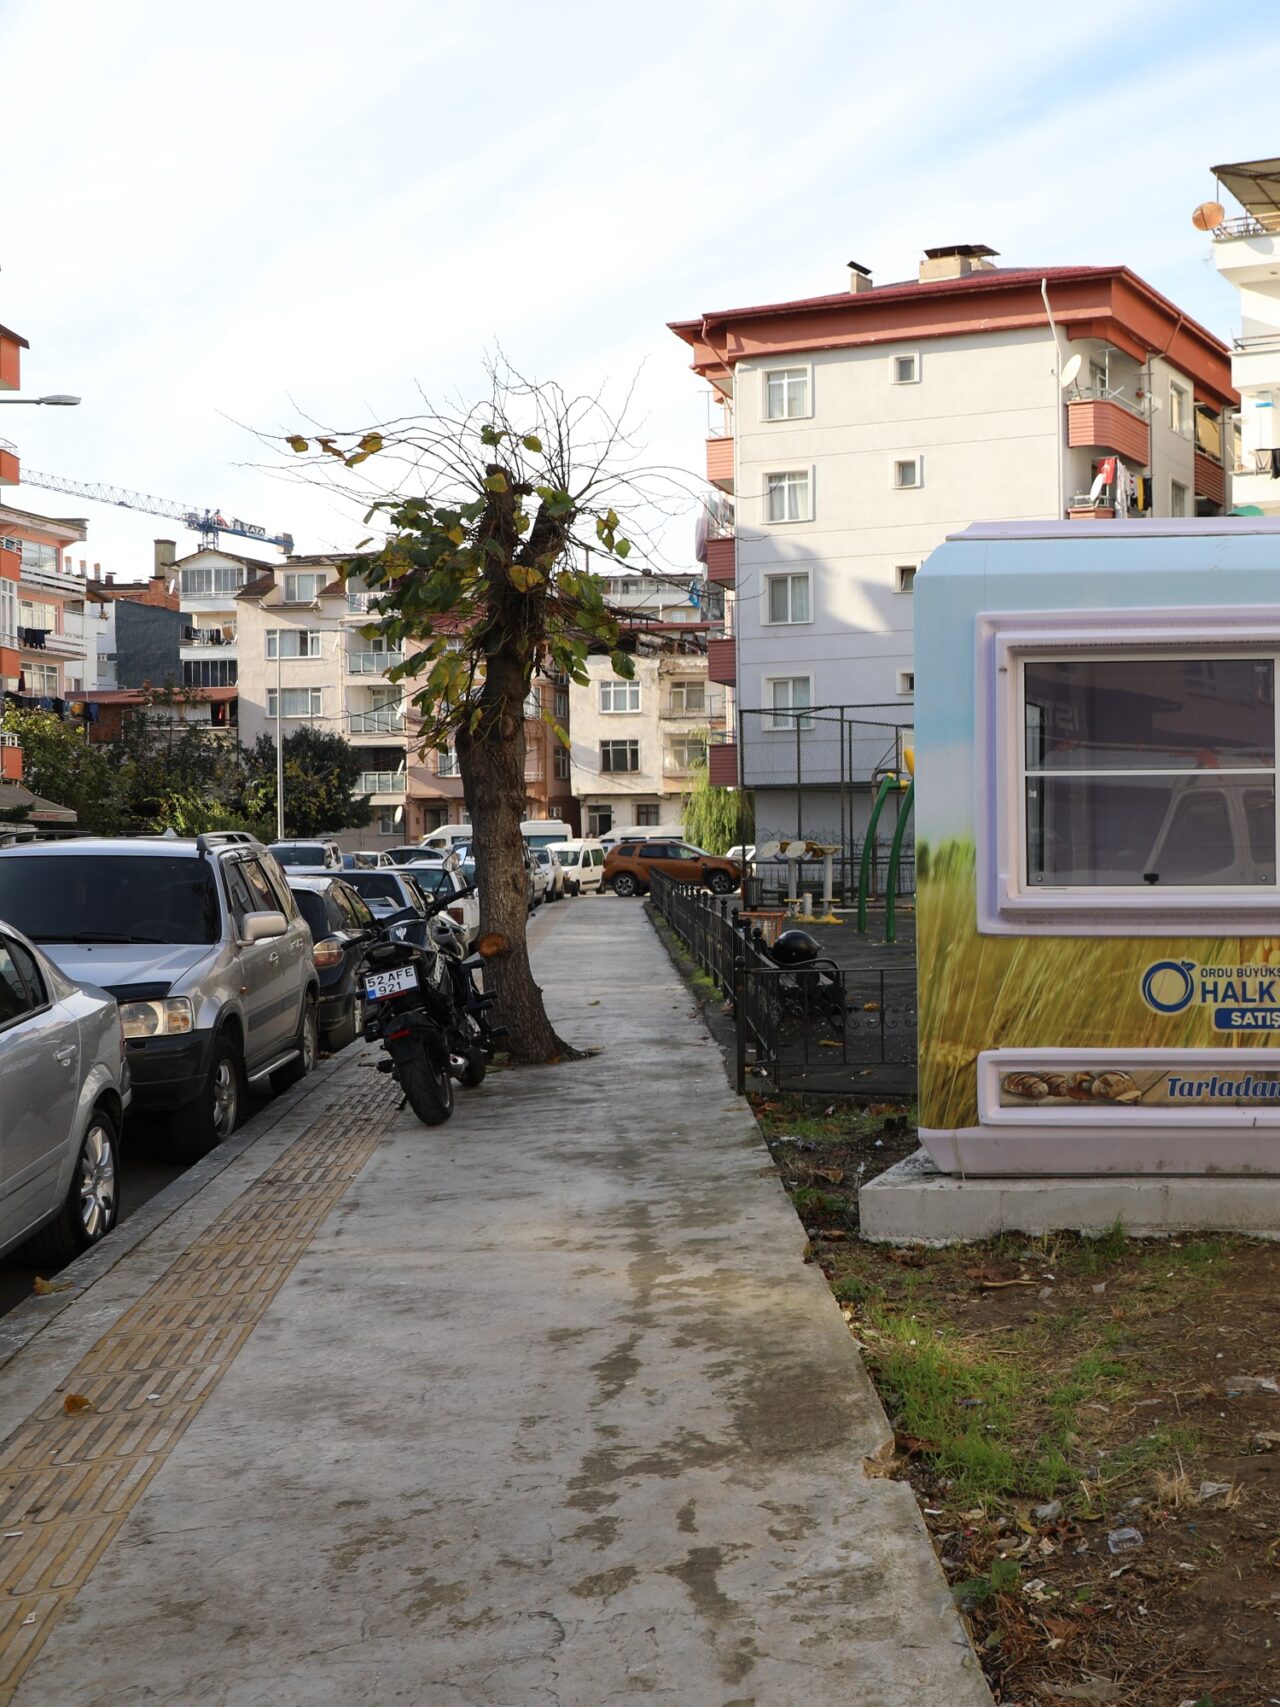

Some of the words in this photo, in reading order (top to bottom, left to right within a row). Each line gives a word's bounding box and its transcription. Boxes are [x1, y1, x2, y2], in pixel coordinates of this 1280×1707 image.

[367, 975, 385, 988] 52
[388, 967, 414, 982] AFE
[1200, 967, 1233, 978] ORDU
[378, 981, 402, 995] 921
[1201, 980, 1276, 1003] HALK
